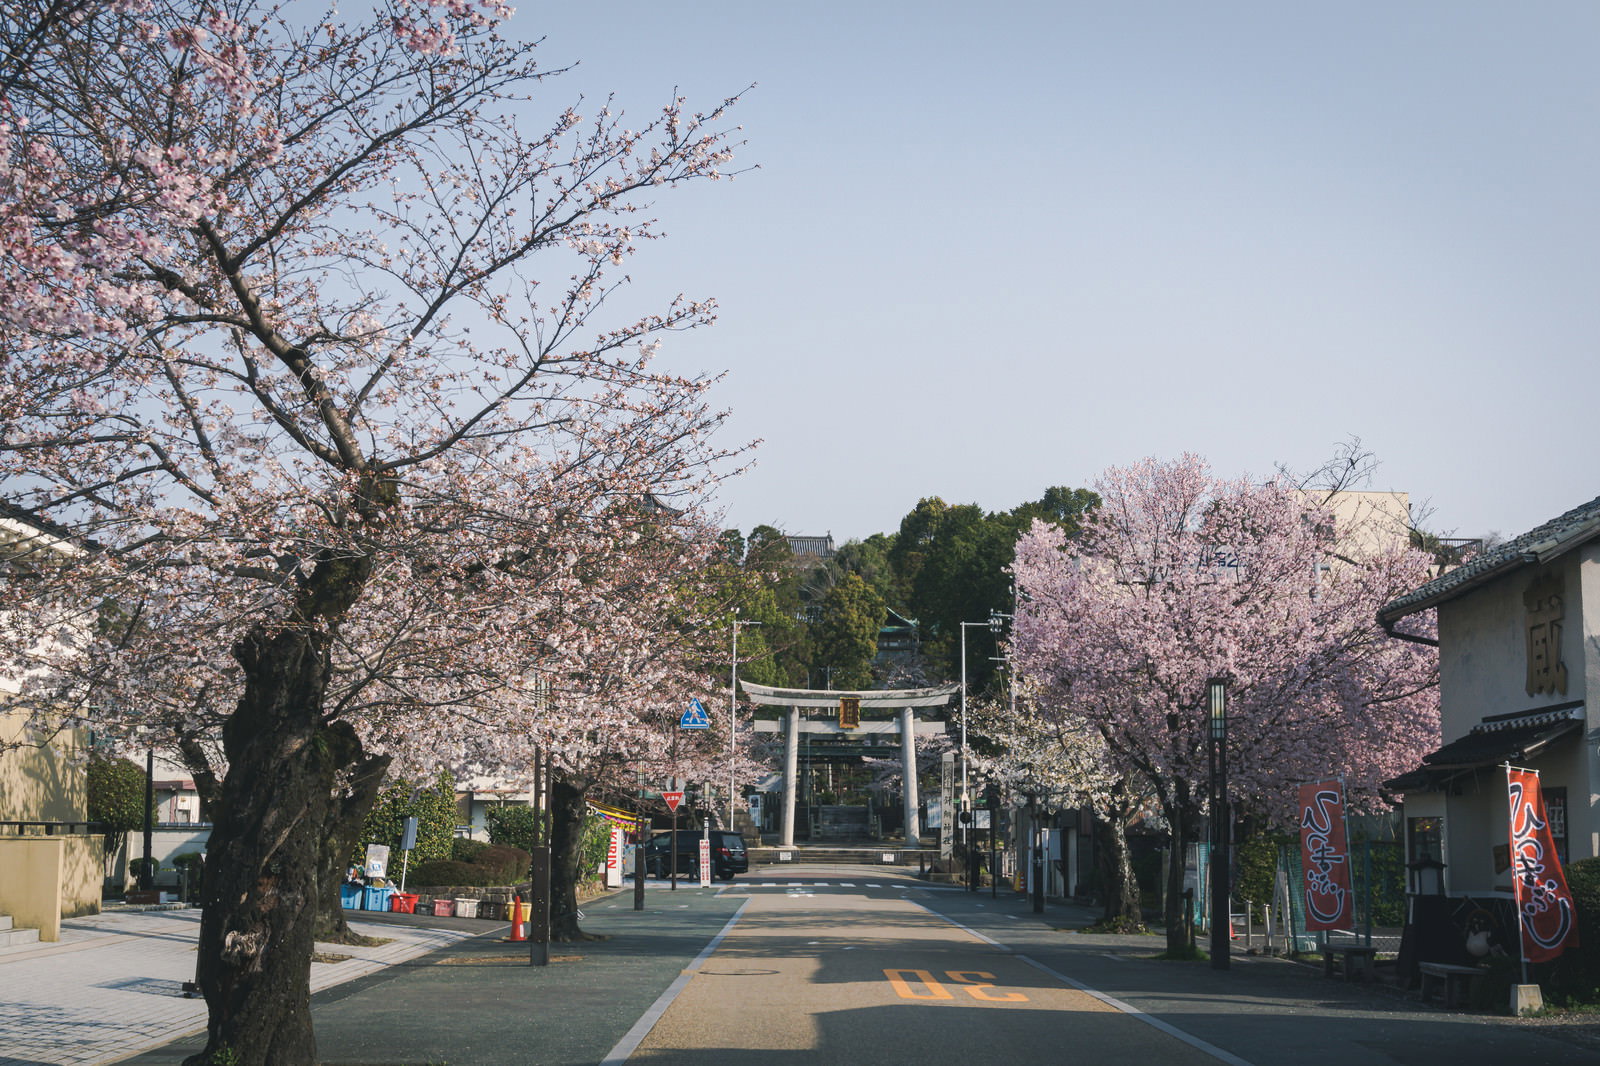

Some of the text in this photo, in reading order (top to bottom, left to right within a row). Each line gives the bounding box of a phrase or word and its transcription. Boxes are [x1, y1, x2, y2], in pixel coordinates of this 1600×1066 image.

[607, 832, 617, 869] KIRIN
[1509, 782, 1571, 949] ひつまぶし
